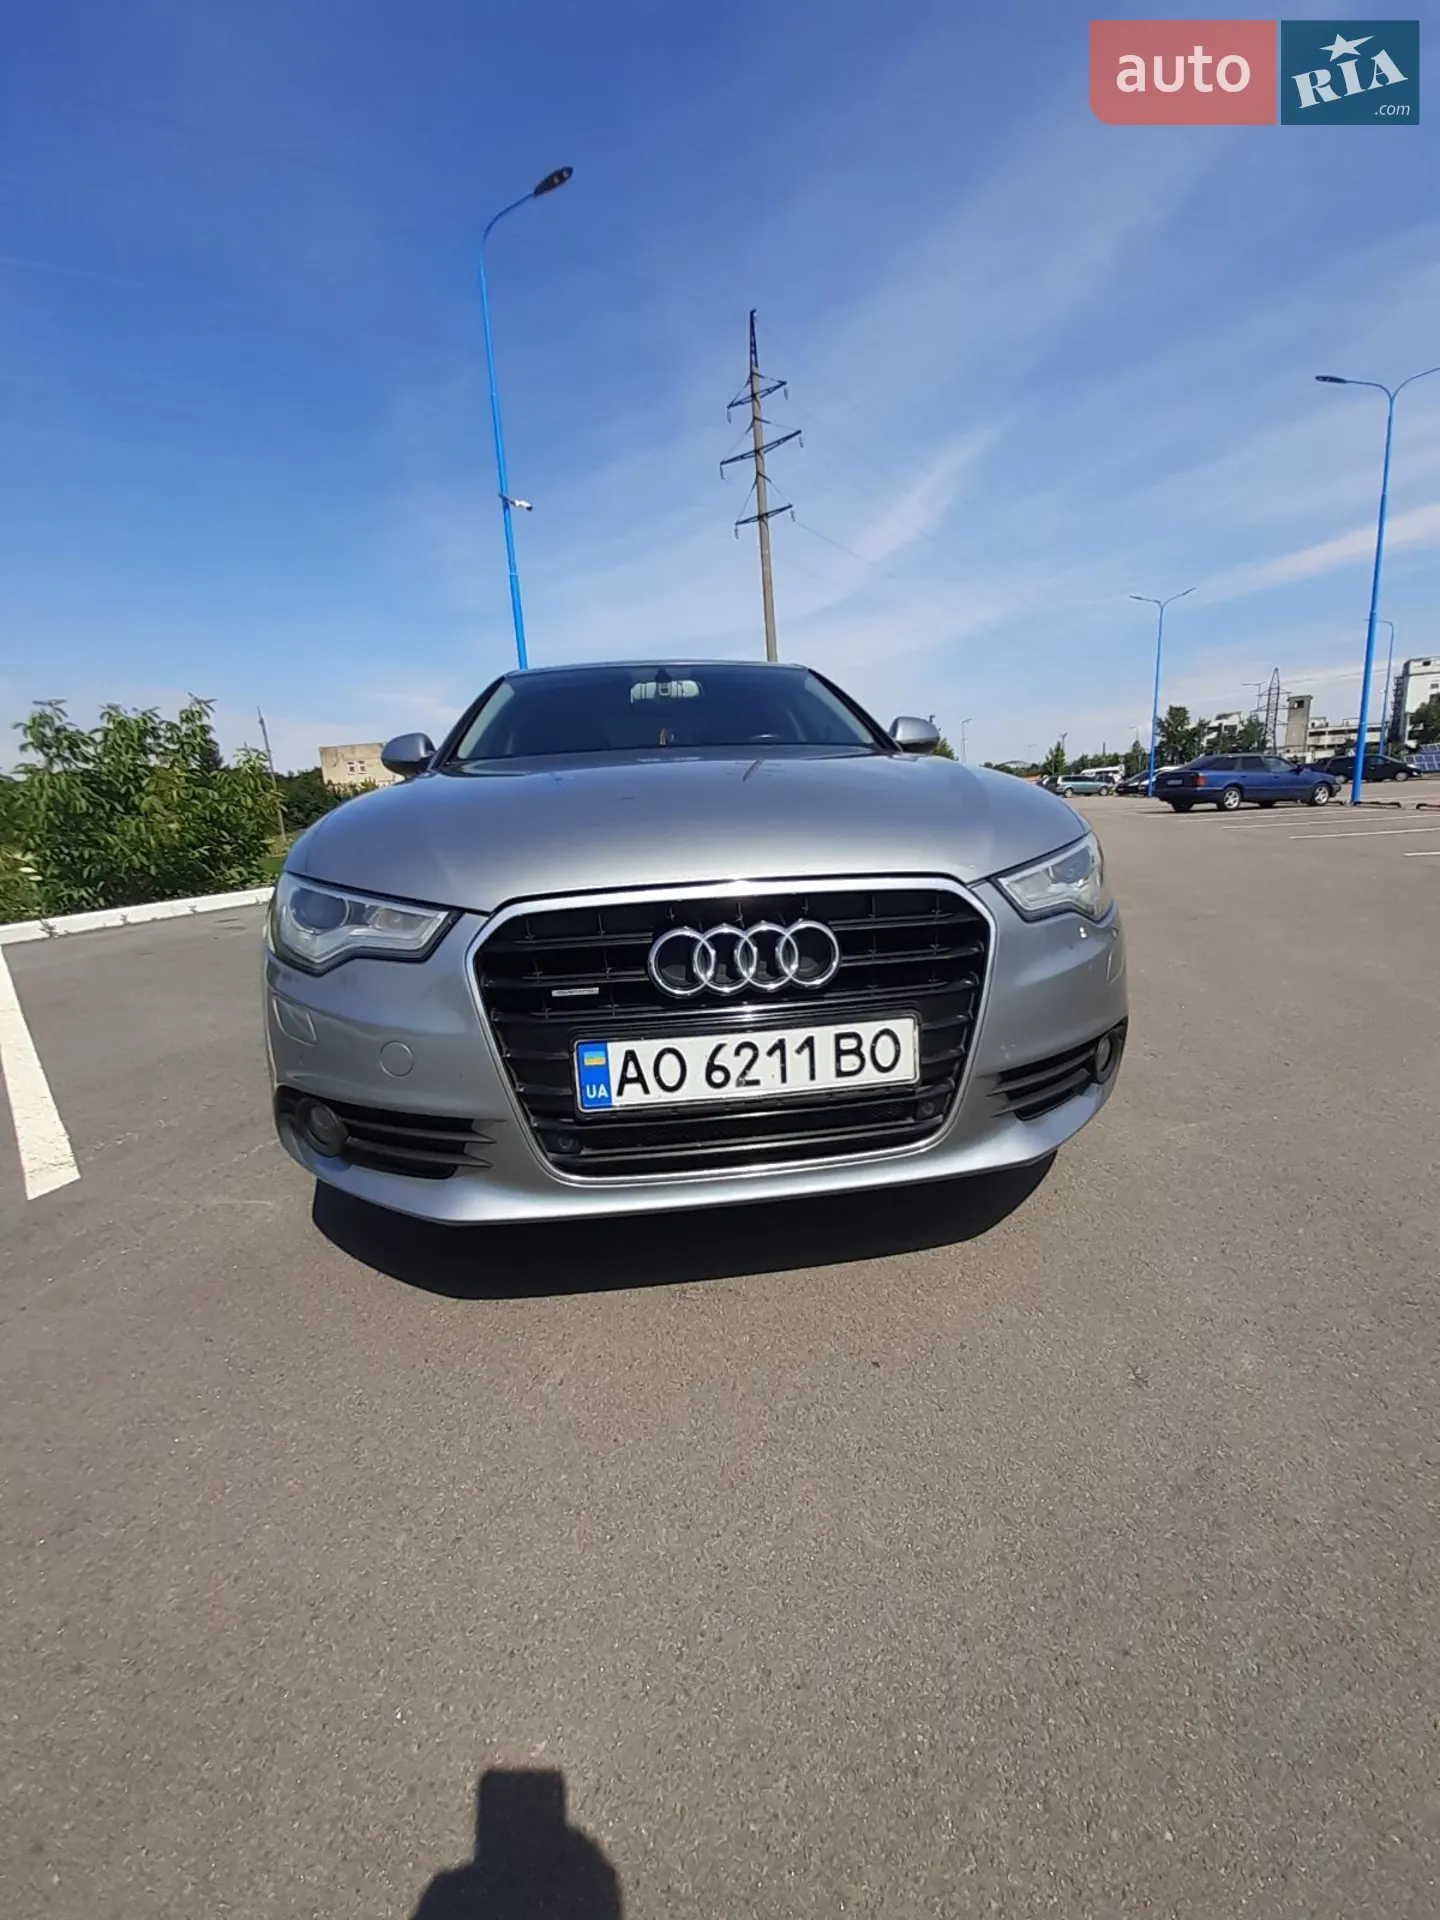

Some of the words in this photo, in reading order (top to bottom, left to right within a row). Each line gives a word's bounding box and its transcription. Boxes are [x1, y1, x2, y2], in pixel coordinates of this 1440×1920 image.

[616, 1047, 687, 1097] AO
[704, 1036, 816, 1090] 6211
[835, 1027, 901, 1078] BO
[586, 1084, 608, 1099] UA
